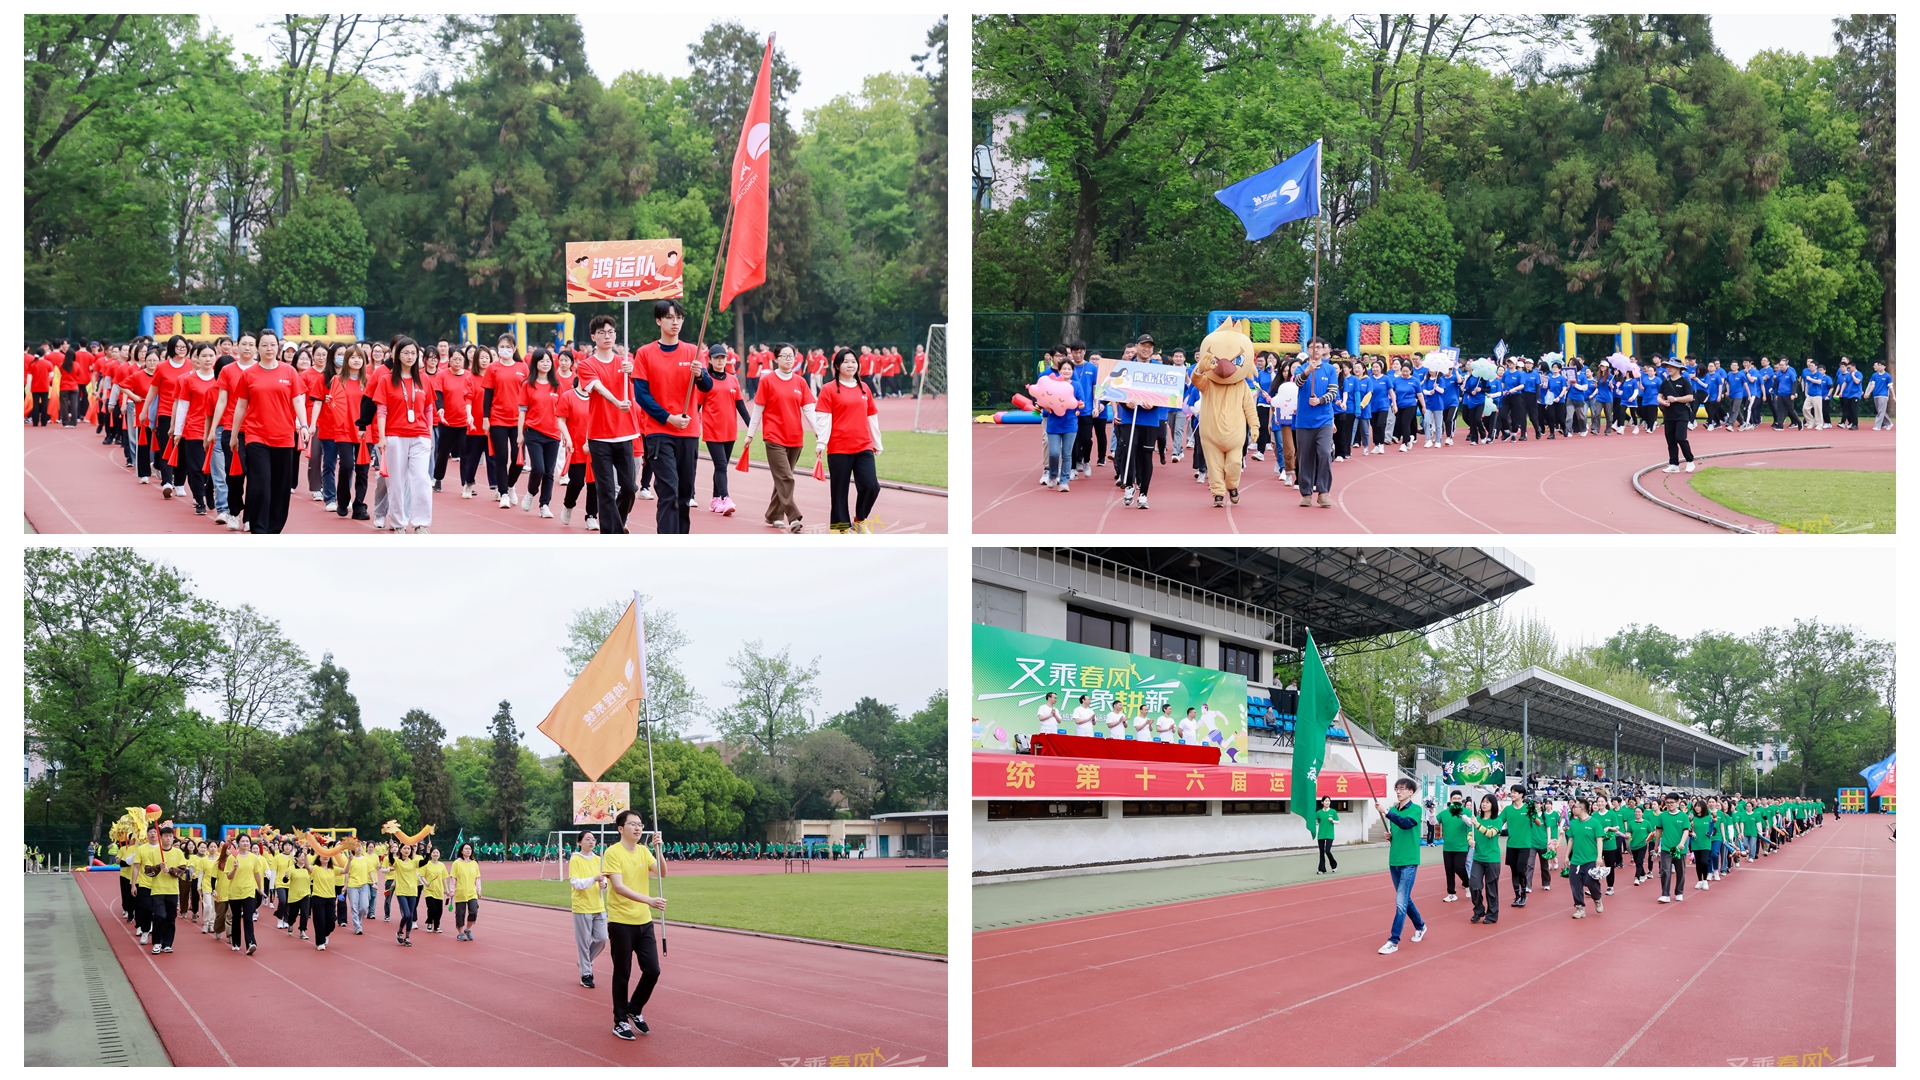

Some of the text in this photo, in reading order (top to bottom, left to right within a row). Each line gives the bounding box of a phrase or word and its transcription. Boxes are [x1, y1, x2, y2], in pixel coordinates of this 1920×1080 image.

[591, 254, 656, 279] 鸿运队
[1133, 371, 1178, 386] 鹰击长空
[1008, 657, 1131, 690] 又乘春风
[1060, 688, 1174, 718] 万象耕新
[1006, 760, 1348, 793] 统第十六届运会
